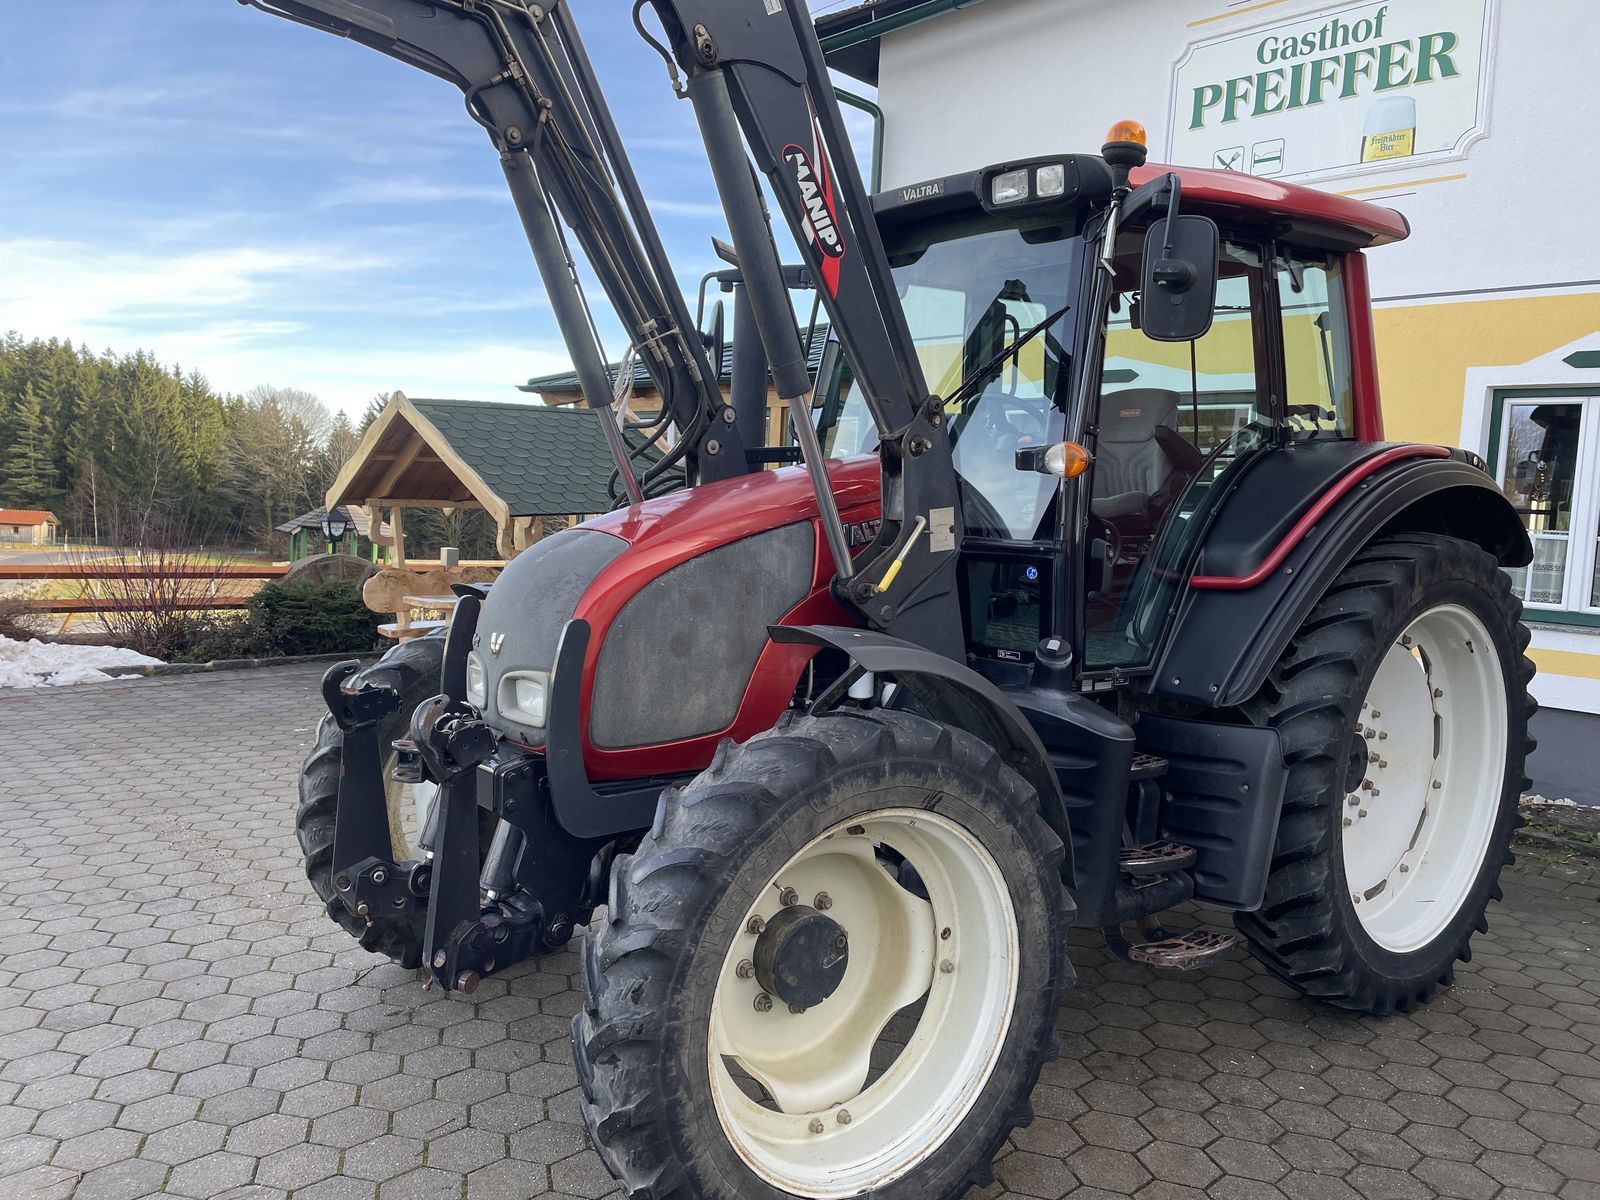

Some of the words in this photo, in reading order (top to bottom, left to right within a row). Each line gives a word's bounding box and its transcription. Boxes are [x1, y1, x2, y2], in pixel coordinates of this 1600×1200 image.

[1256, 5, 1388, 64] Gasthof
[1188, 31, 1461, 131] PFEIFFER
[903, 183, 940, 201] VALTRA
